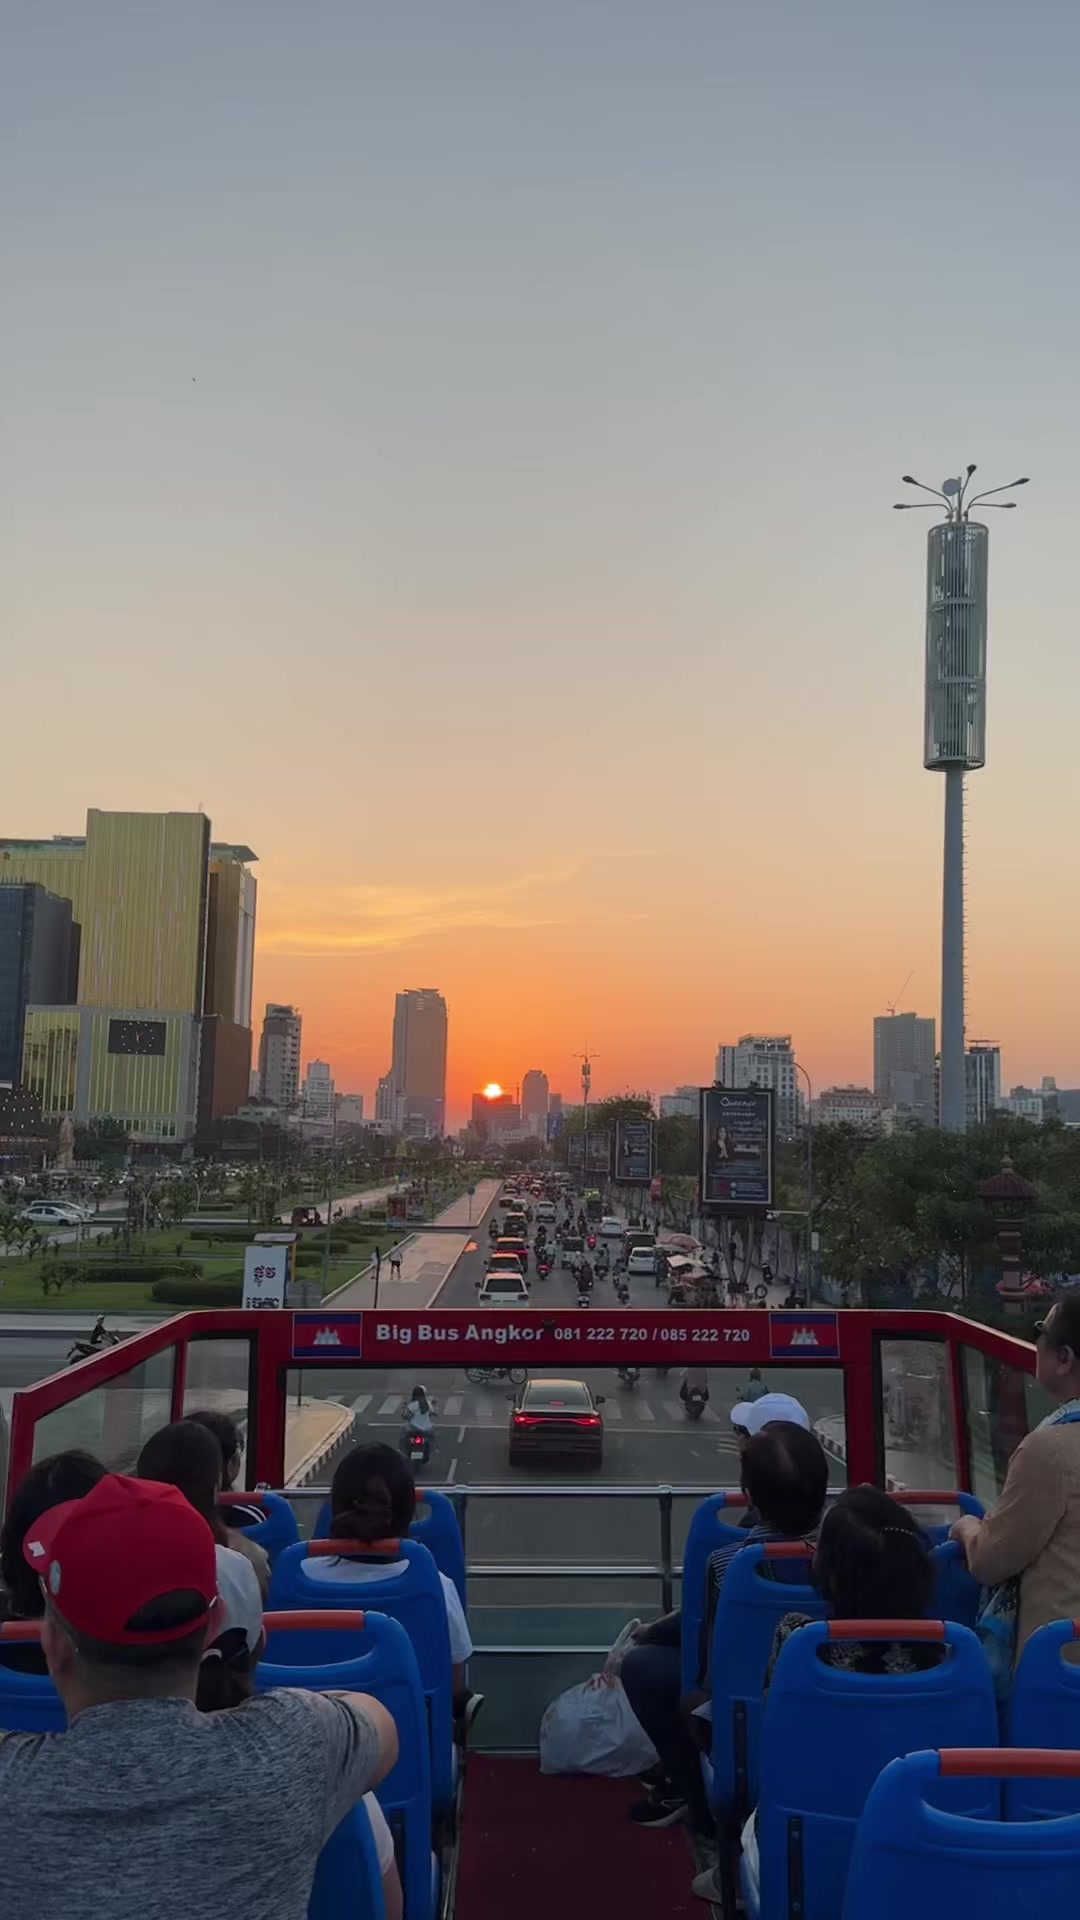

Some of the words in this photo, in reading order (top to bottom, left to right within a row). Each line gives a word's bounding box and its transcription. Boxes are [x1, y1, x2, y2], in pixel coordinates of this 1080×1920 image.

[375, 1324, 412, 1344] Big
[418, 1324, 460, 1341] Bus
[465, 1324, 544, 1344] Angkor
[554, 1327, 581, 1341] 081
[586, 1327, 615, 1341] 222
[619, 1328, 648, 1341] 720
[691, 1328, 719, 1342] 222
[723, 1329, 751, 1342] 720
